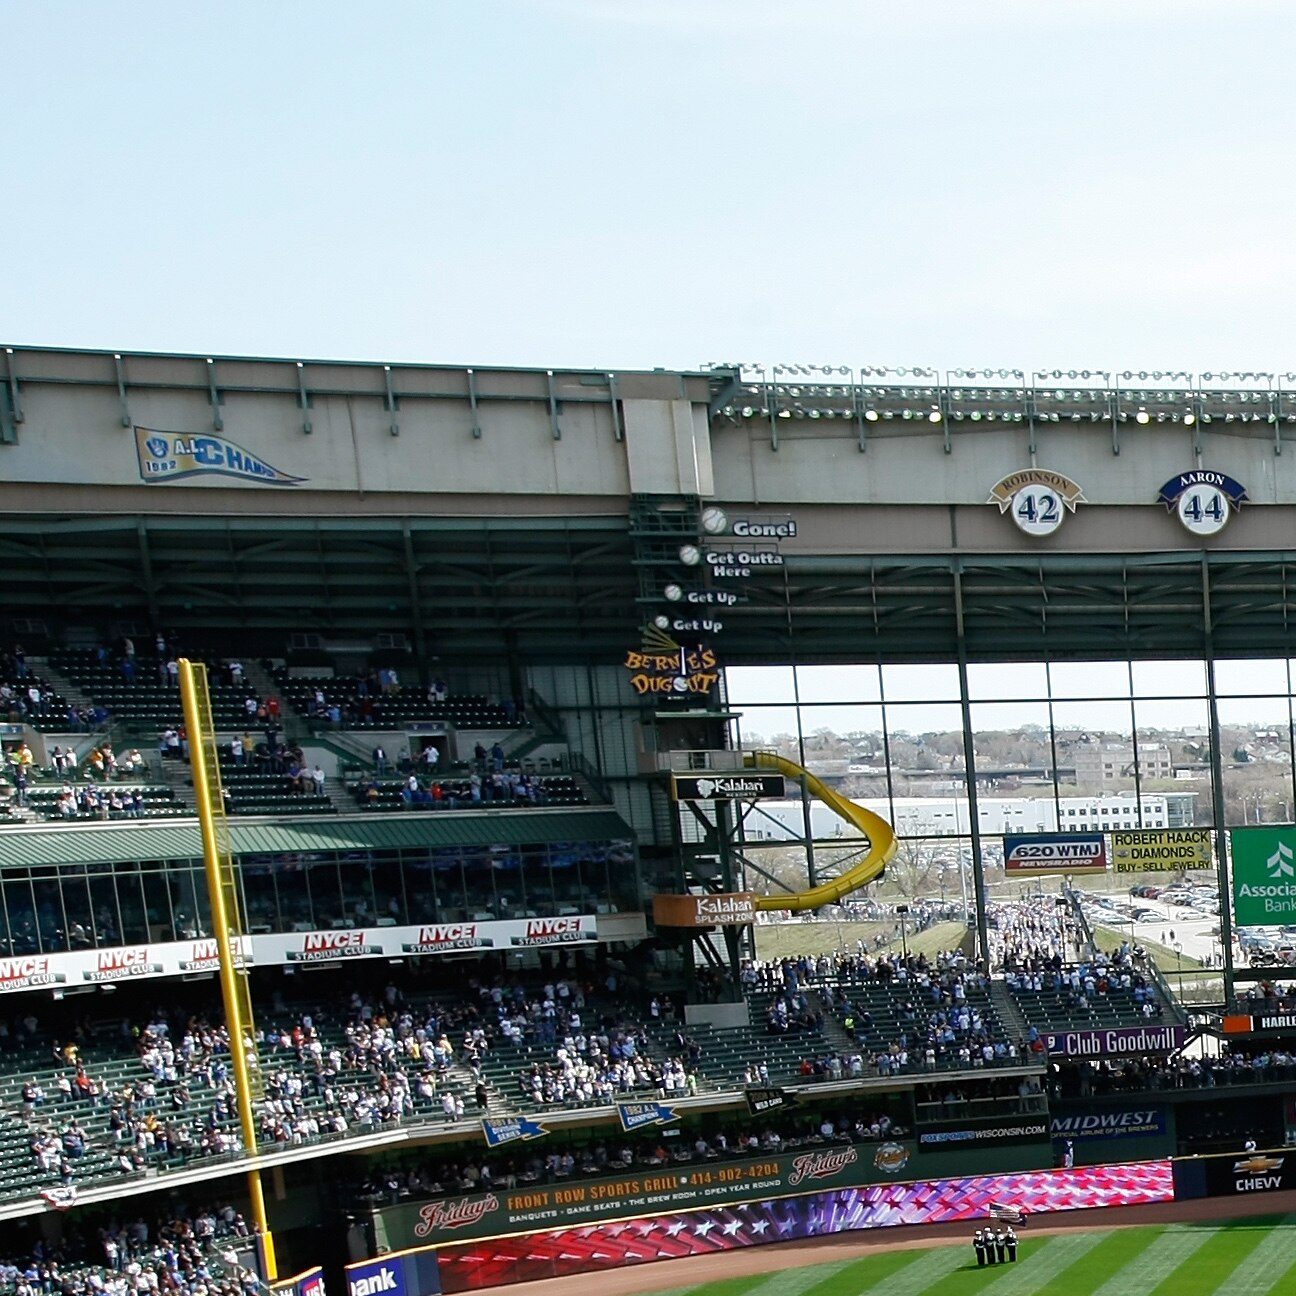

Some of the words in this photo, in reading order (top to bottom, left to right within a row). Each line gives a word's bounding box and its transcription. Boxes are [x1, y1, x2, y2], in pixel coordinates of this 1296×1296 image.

[1003, 471, 1070, 491] ROBINSON
[1180, 471, 1225, 486] AARON
[1018, 494, 1060, 523] 42
[1184, 494, 1224, 523] 44
[733, 521, 797, 536] Gone!
[706, 552, 734, 565] Get
[738, 552, 783, 565] Outta
[714, 566, 750, 577] Here
[688, 592, 713, 603] Get
[717, 592, 737, 605] Up
[673, 620, 699, 631] Get
[702, 620, 723, 632] Up
[714, 778, 764, 793] Kalahari
[1115, 833, 1164, 846] ROBERT
[1167, 831, 1209, 844] HAACK
[1015, 845, 1055, 858] 620
[1057, 844, 1100, 857] WTMJ
[1131, 846, 1195, 859] DIAMONDS
[1019, 859, 1093, 867] NEWSRADIO
[1168, 861, 1210, 871] JEWELRY
[695, 912, 734, 924] SPLASH
[419, 925, 477, 943] NYCE
[526, 918, 582, 936] NYCE
[304, 932, 365, 950] NYCE
[410, 942, 453, 953] STADIUM
[454, 938, 482, 949] CLUB
[519, 935, 558, 946] STADIUM
[560, 931, 587, 942] CLUB
[98, 948, 147, 970] NYCE
[294, 949, 342, 962] STADIUM
[344, 945, 372, 957] CLUB
[90, 968, 128, 981] STADIUM
[130, 963, 155, 975] CLUB
[1066, 1029, 1100, 1055] Club
[1105, 1027, 1177, 1053] Goodwill
[1051, 1110, 1158, 1131] MIDWEST
[788, 1145, 858, 1185] Friday's
[508, 1192, 549, 1211] FRONT
[555, 1188, 585, 1205] ROW
[590, 1181, 640, 1199] SPORTS
[644, 1176, 679, 1192] GRILL
[690, 1163, 780, 1185] 414-902-4204
[1236, 1176, 1282, 1192] CHEVY
[509, 1210, 557, 1223] BANQUETS
[567, 1205, 591, 1215] GAME
[593, 1202, 620, 1213] SEATS
[629, 1197, 645, 1206] THE
[647, 1194, 671, 1204] BREW
[673, 1191, 696, 1201] ROOM
[704, 1187, 728, 1196] OPEN
[729, 1183, 750, 1192] YEAR
[752, 1179, 781, 1189] ROUND
[414, 1193, 499, 1237] Friday's
